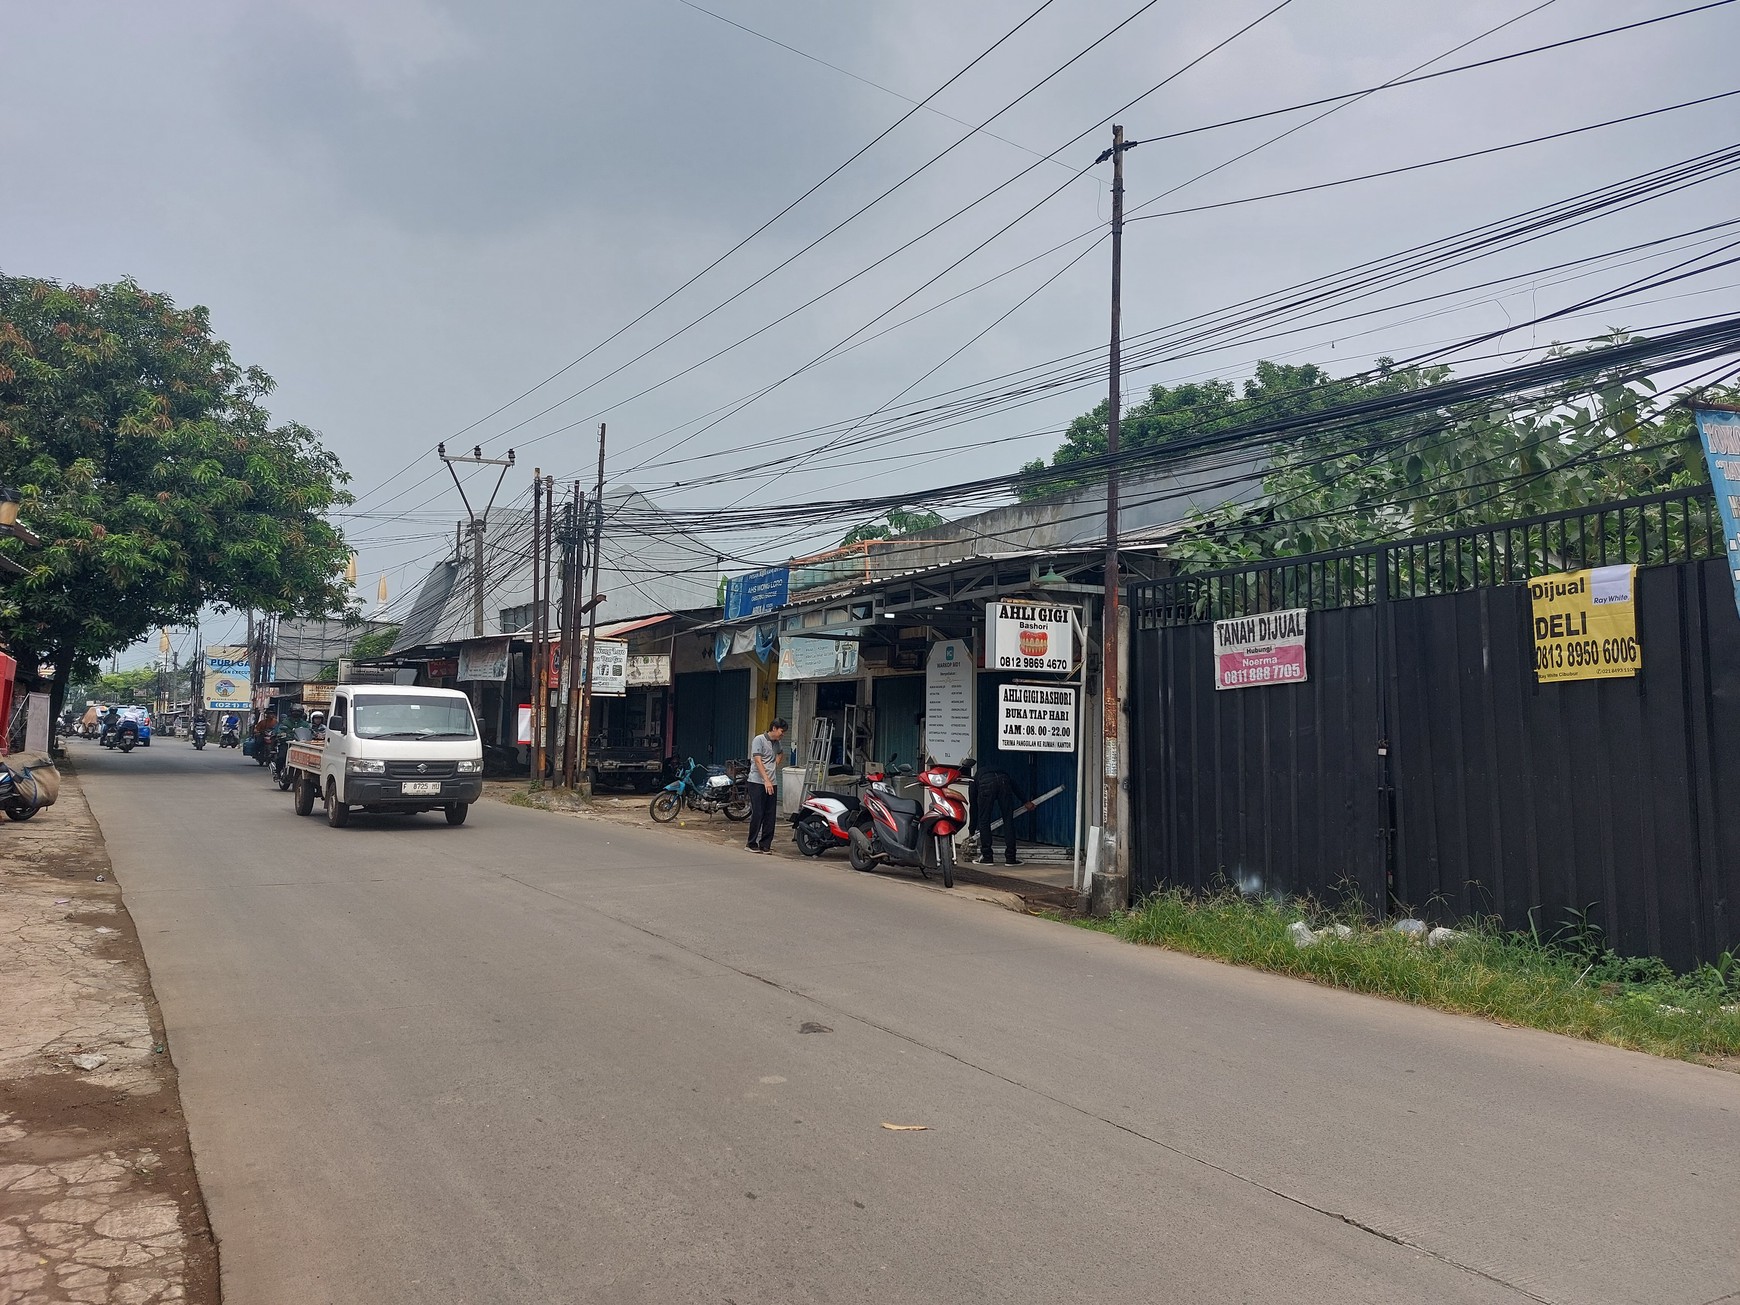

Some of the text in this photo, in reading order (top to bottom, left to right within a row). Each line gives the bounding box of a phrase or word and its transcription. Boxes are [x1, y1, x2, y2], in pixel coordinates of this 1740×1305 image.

[1531, 577, 1585, 602] Dijual
[999, 605, 1069, 624] AHLI GIGI
[1019, 622, 1049, 631] Bashori
[1217, 612, 1304, 646] TANAH DIJUAL
[1535, 612, 1587, 640] DELI
[1246, 646, 1273, 654] Hubungi
[1567, 640, 1599, 667] 8950
[1603, 636, 1637, 664] 6006
[210, 659, 234, 667] PURI
[1000, 656, 1067, 670] 0812 9869 4670
[1242, 656, 1278, 667] Noerma
[1224, 668, 1247, 684] 0811
[1272, 663, 1300, 678] 7705
[1003, 688, 1072, 706] AHLI GIGI BASHORI
[1005, 708, 1069, 721] BUKA TIAP HARI
[1003, 724, 1022, 735] JAM
[1051, 726, 1071, 737] 22.00
